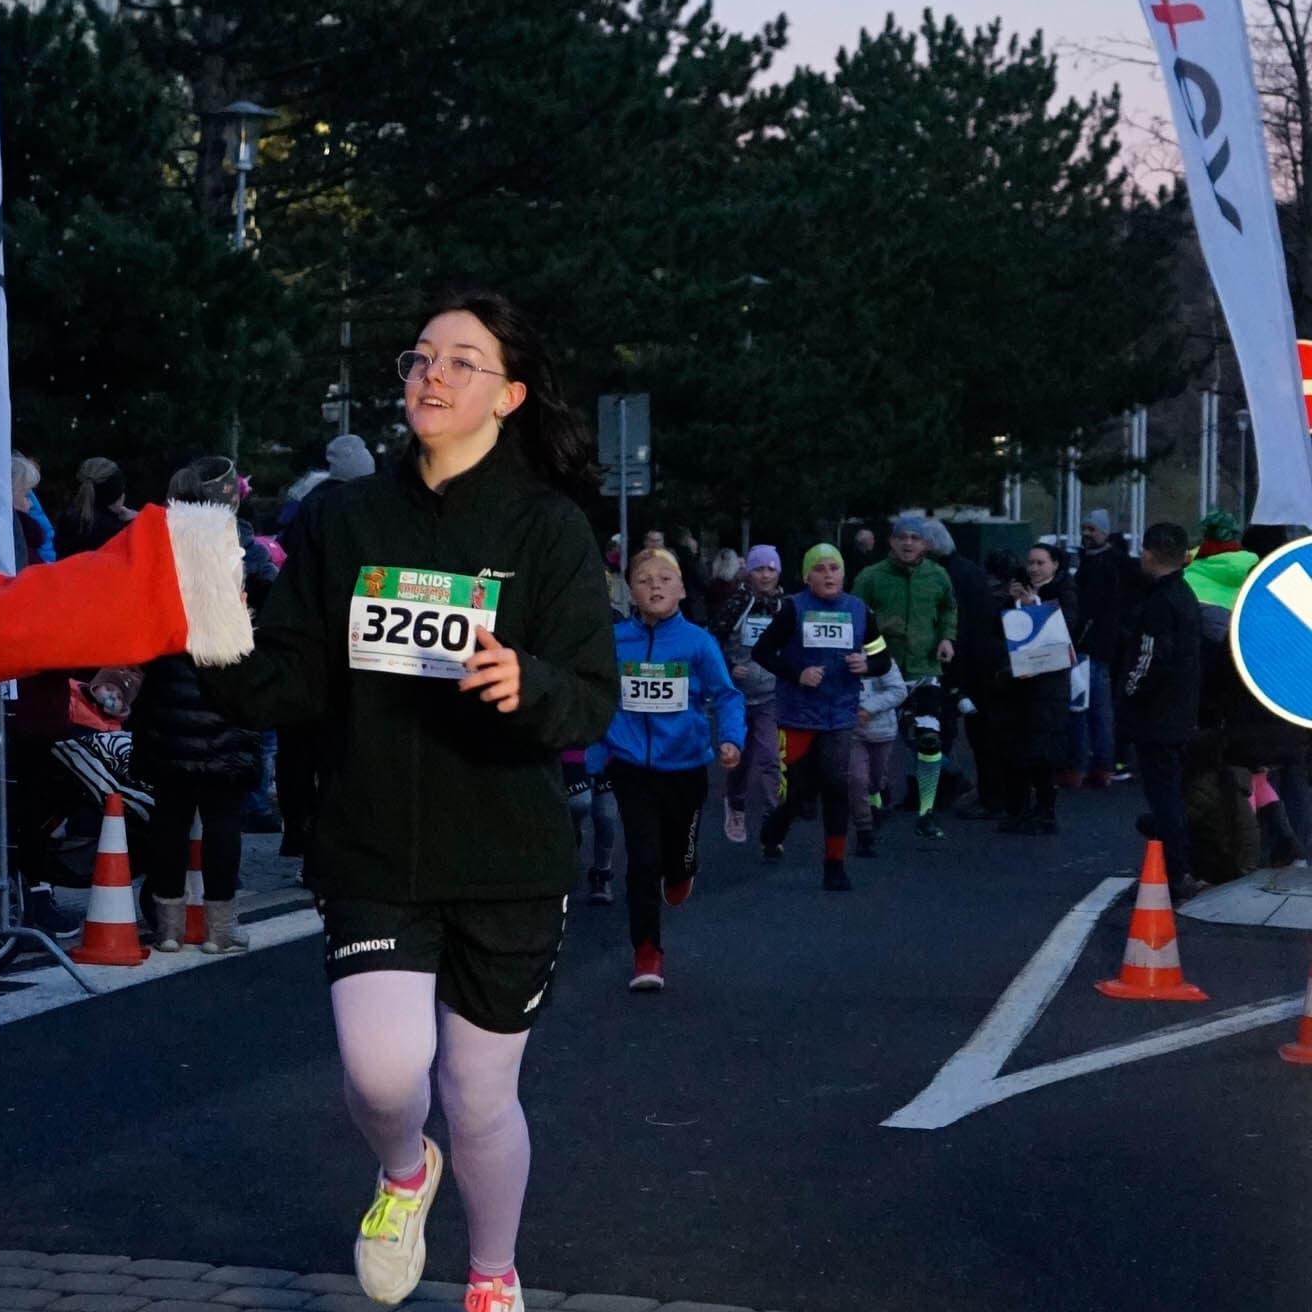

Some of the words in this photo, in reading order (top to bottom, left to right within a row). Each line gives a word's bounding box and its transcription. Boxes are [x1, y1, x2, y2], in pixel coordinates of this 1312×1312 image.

[418, 573, 452, 587] KIDS
[362, 604, 469, 651] 3260
[813, 624, 843, 638] 3151
[630, 679, 673, 700] 3155
